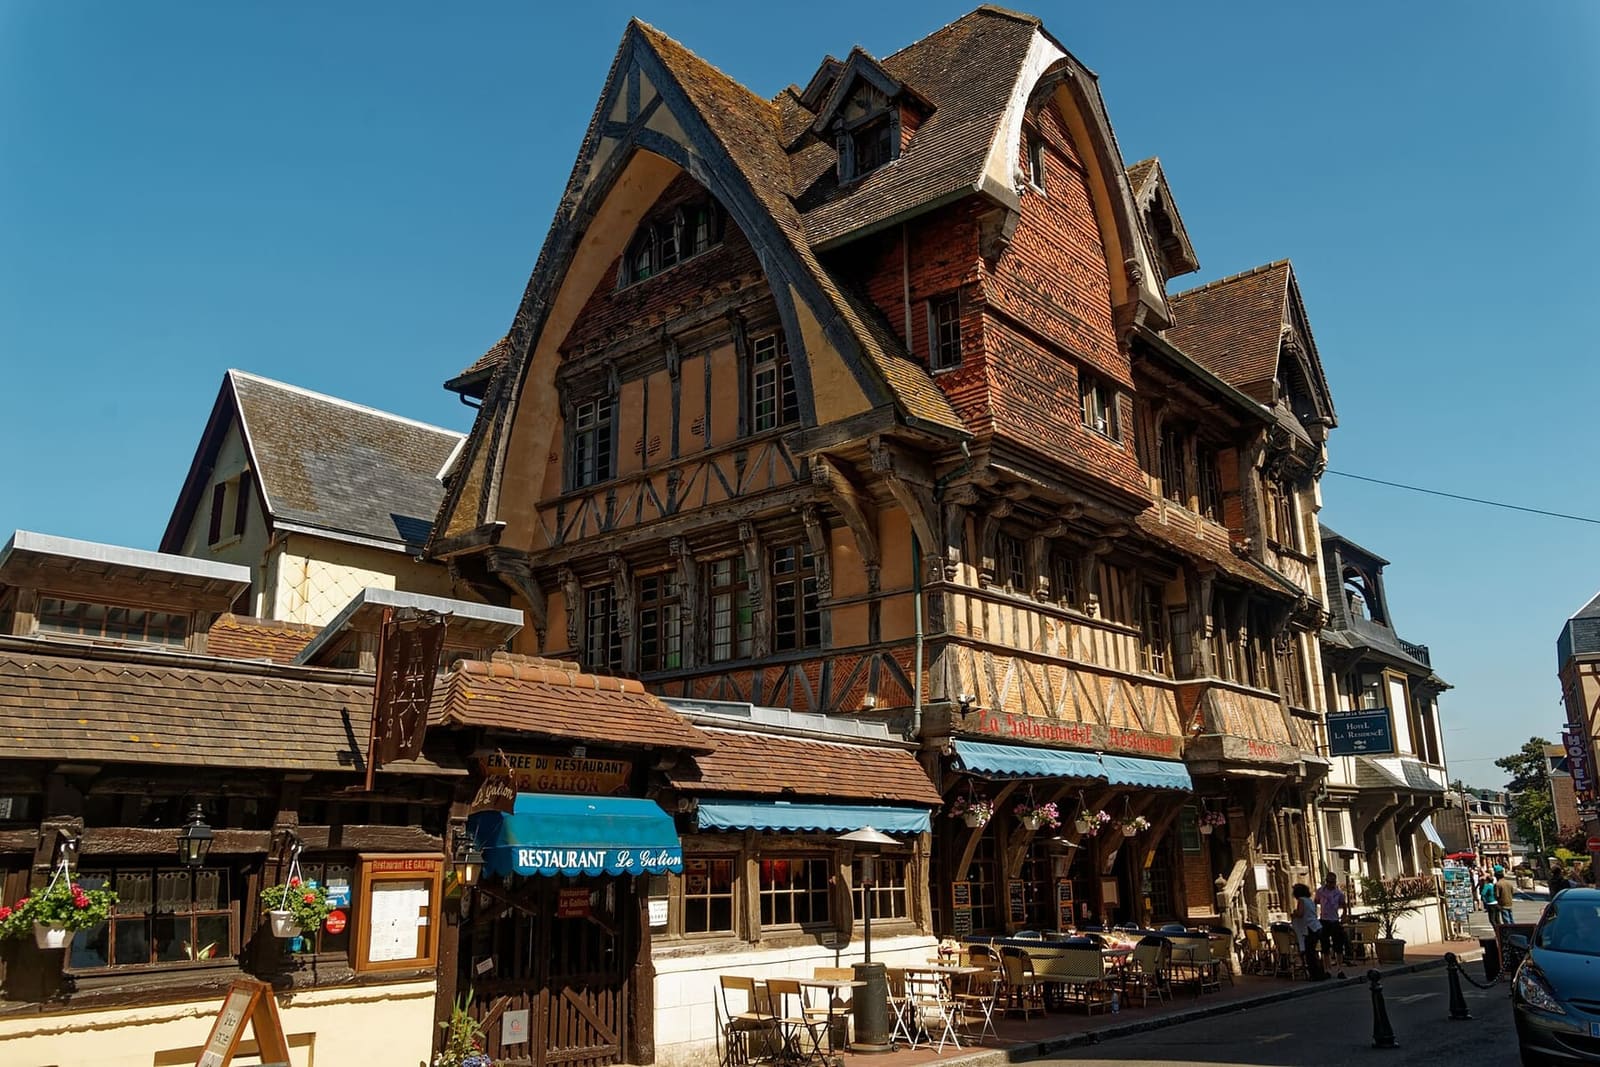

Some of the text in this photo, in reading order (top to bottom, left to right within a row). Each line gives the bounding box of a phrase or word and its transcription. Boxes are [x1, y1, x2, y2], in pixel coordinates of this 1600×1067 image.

[977, 709, 999, 733] La
[535, 758, 548, 770] DU
[554, 760, 624, 775] RESTAURANT
[537, 775, 600, 793] GALION
[405, 860, 413, 870] LE
[518, 849, 682, 868] RESTAURANT Le Galion
